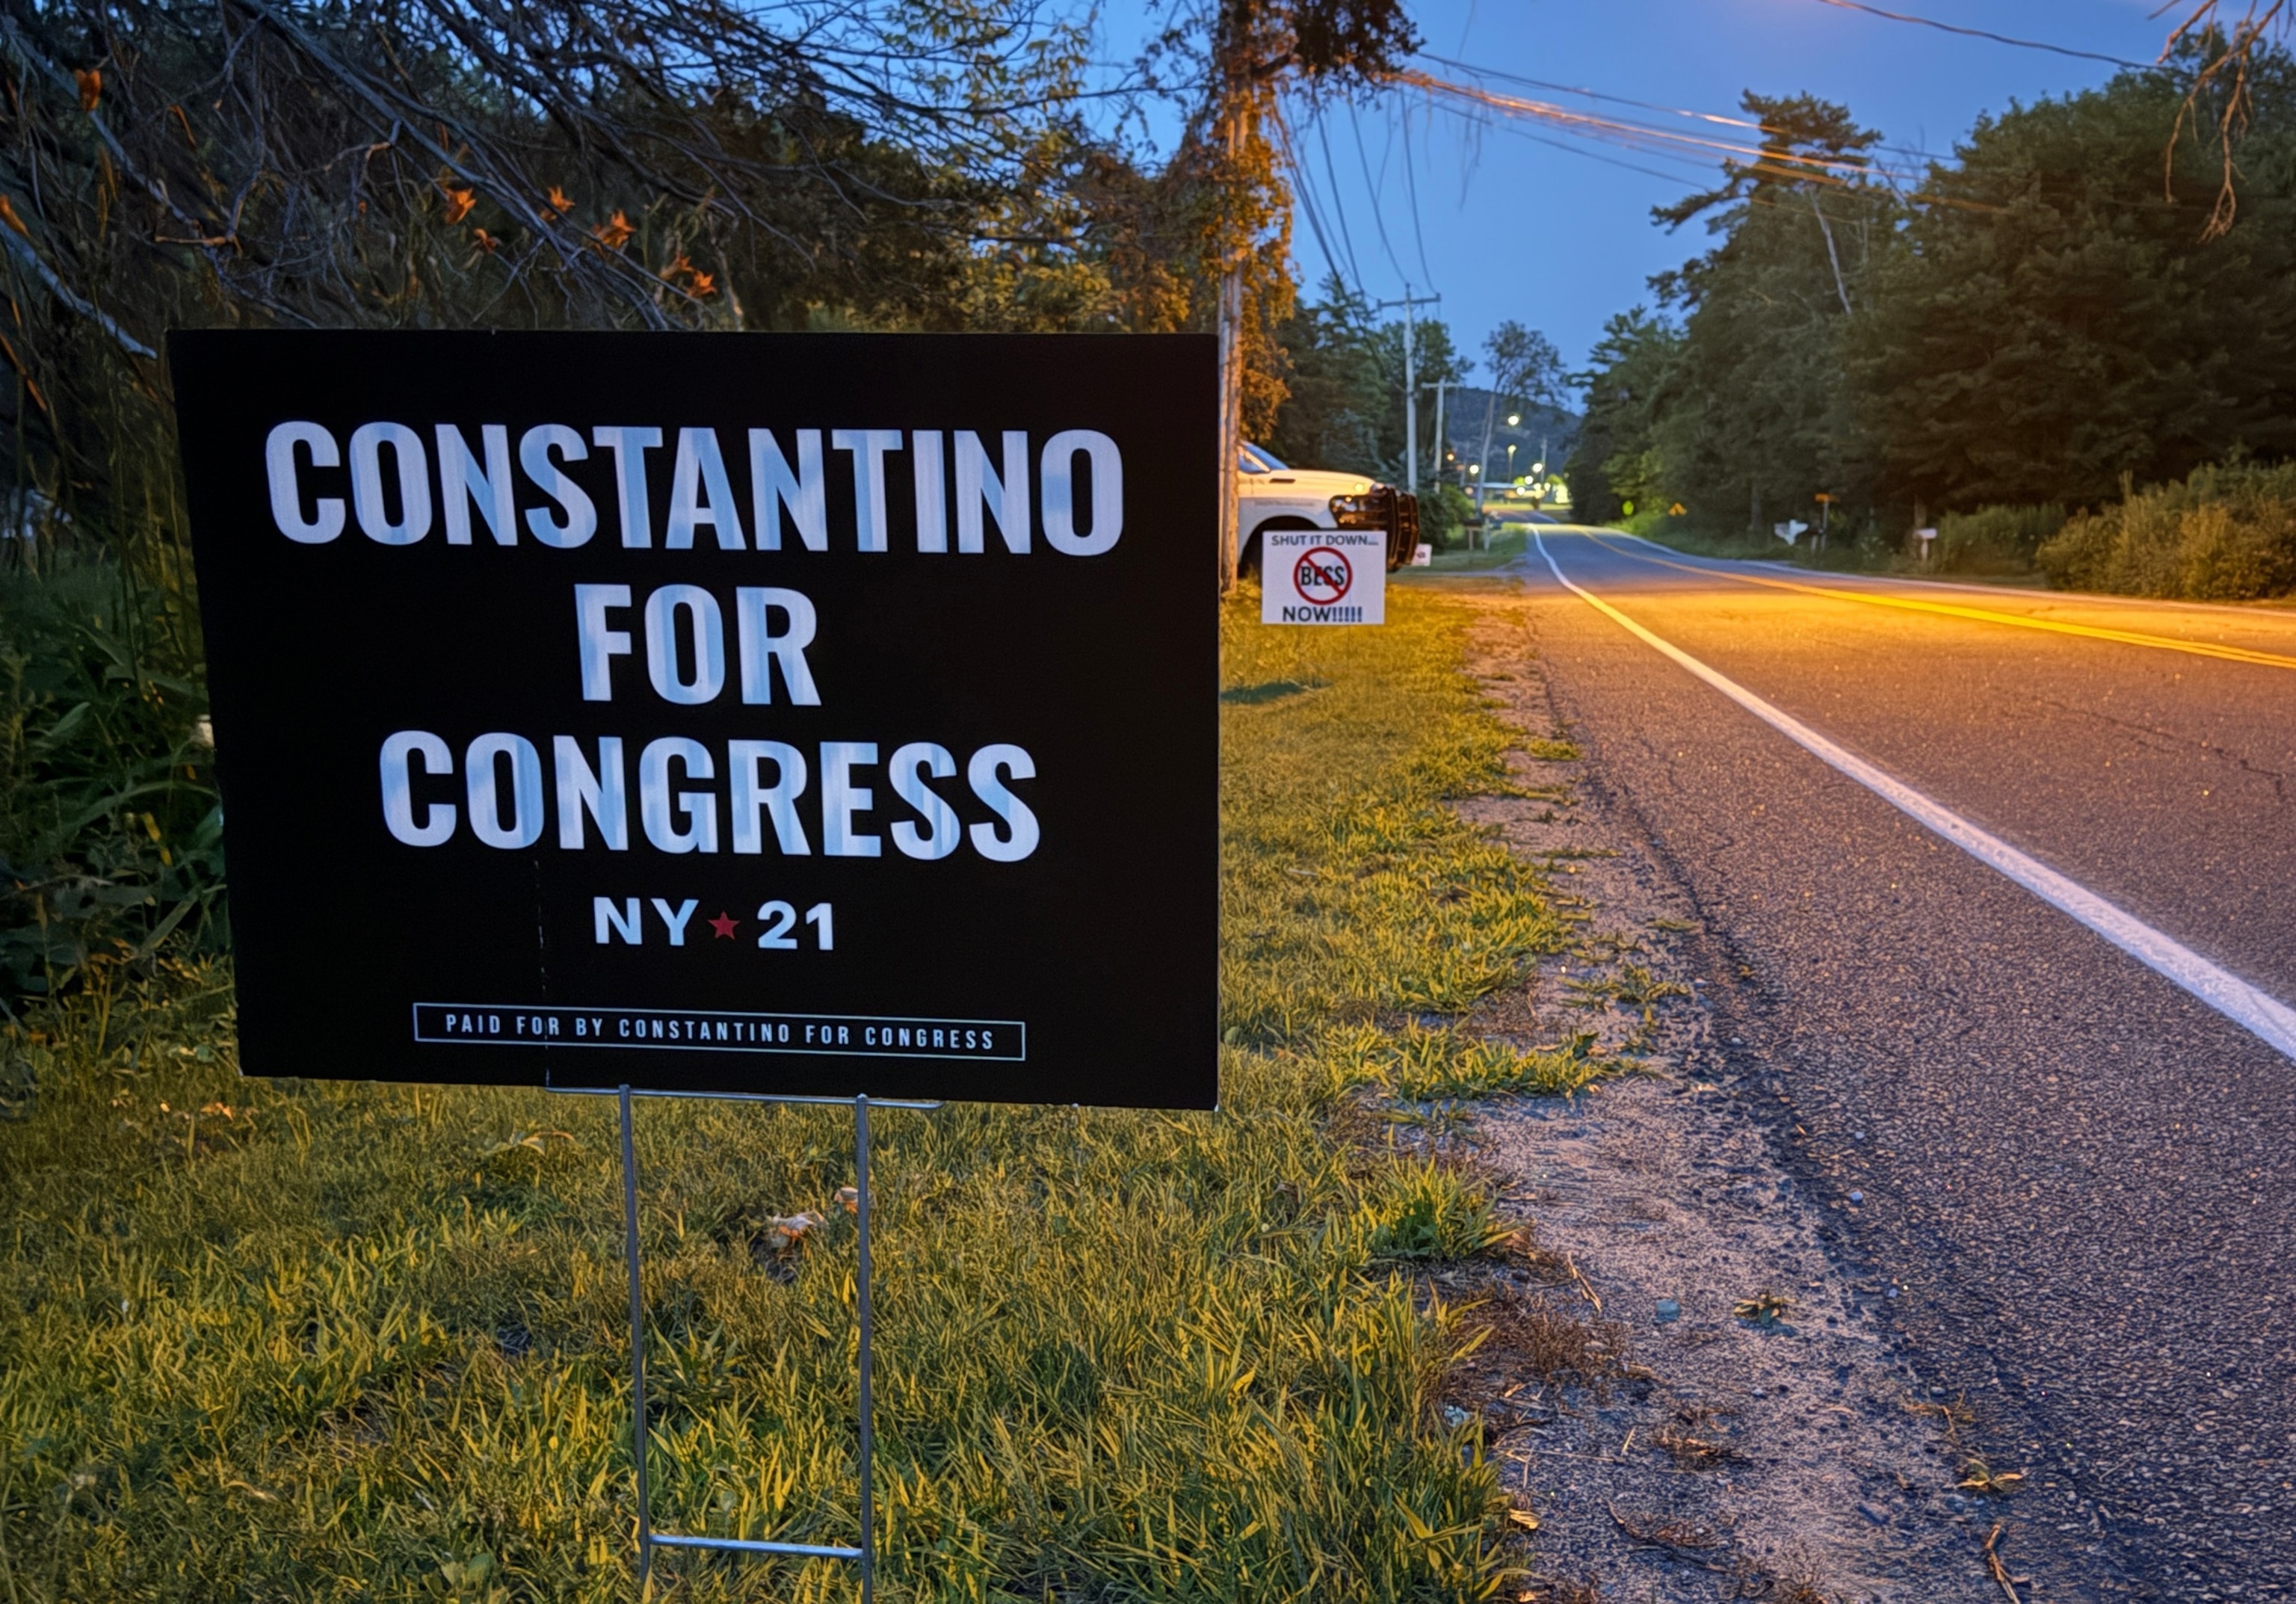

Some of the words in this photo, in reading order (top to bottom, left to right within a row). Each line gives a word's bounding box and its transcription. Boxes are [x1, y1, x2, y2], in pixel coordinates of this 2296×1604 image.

[266, 421, 1123, 556] CONSTANTINO
[1271, 534, 1306, 546] SHUT
[1310, 535, 1322, 545] IT
[1300, 565, 1345, 586] BESS
[1283, 606, 1363, 623] NOW!!!!!
[575, 584, 821, 706] FOR
[380, 730, 1040, 863] CONGRESS
[593, 896, 699, 946] NY
[757, 900, 834, 951] 21
[446, 1014, 500, 1033] PAID
[516, 1016, 559, 1035] FOR
[575, 1017, 602, 1036] BY
[619, 1019, 789, 1043] CONSTANTINO
[806, 1025, 849, 1045] FOR
[865, 1026, 993, 1049] CONGRESS
